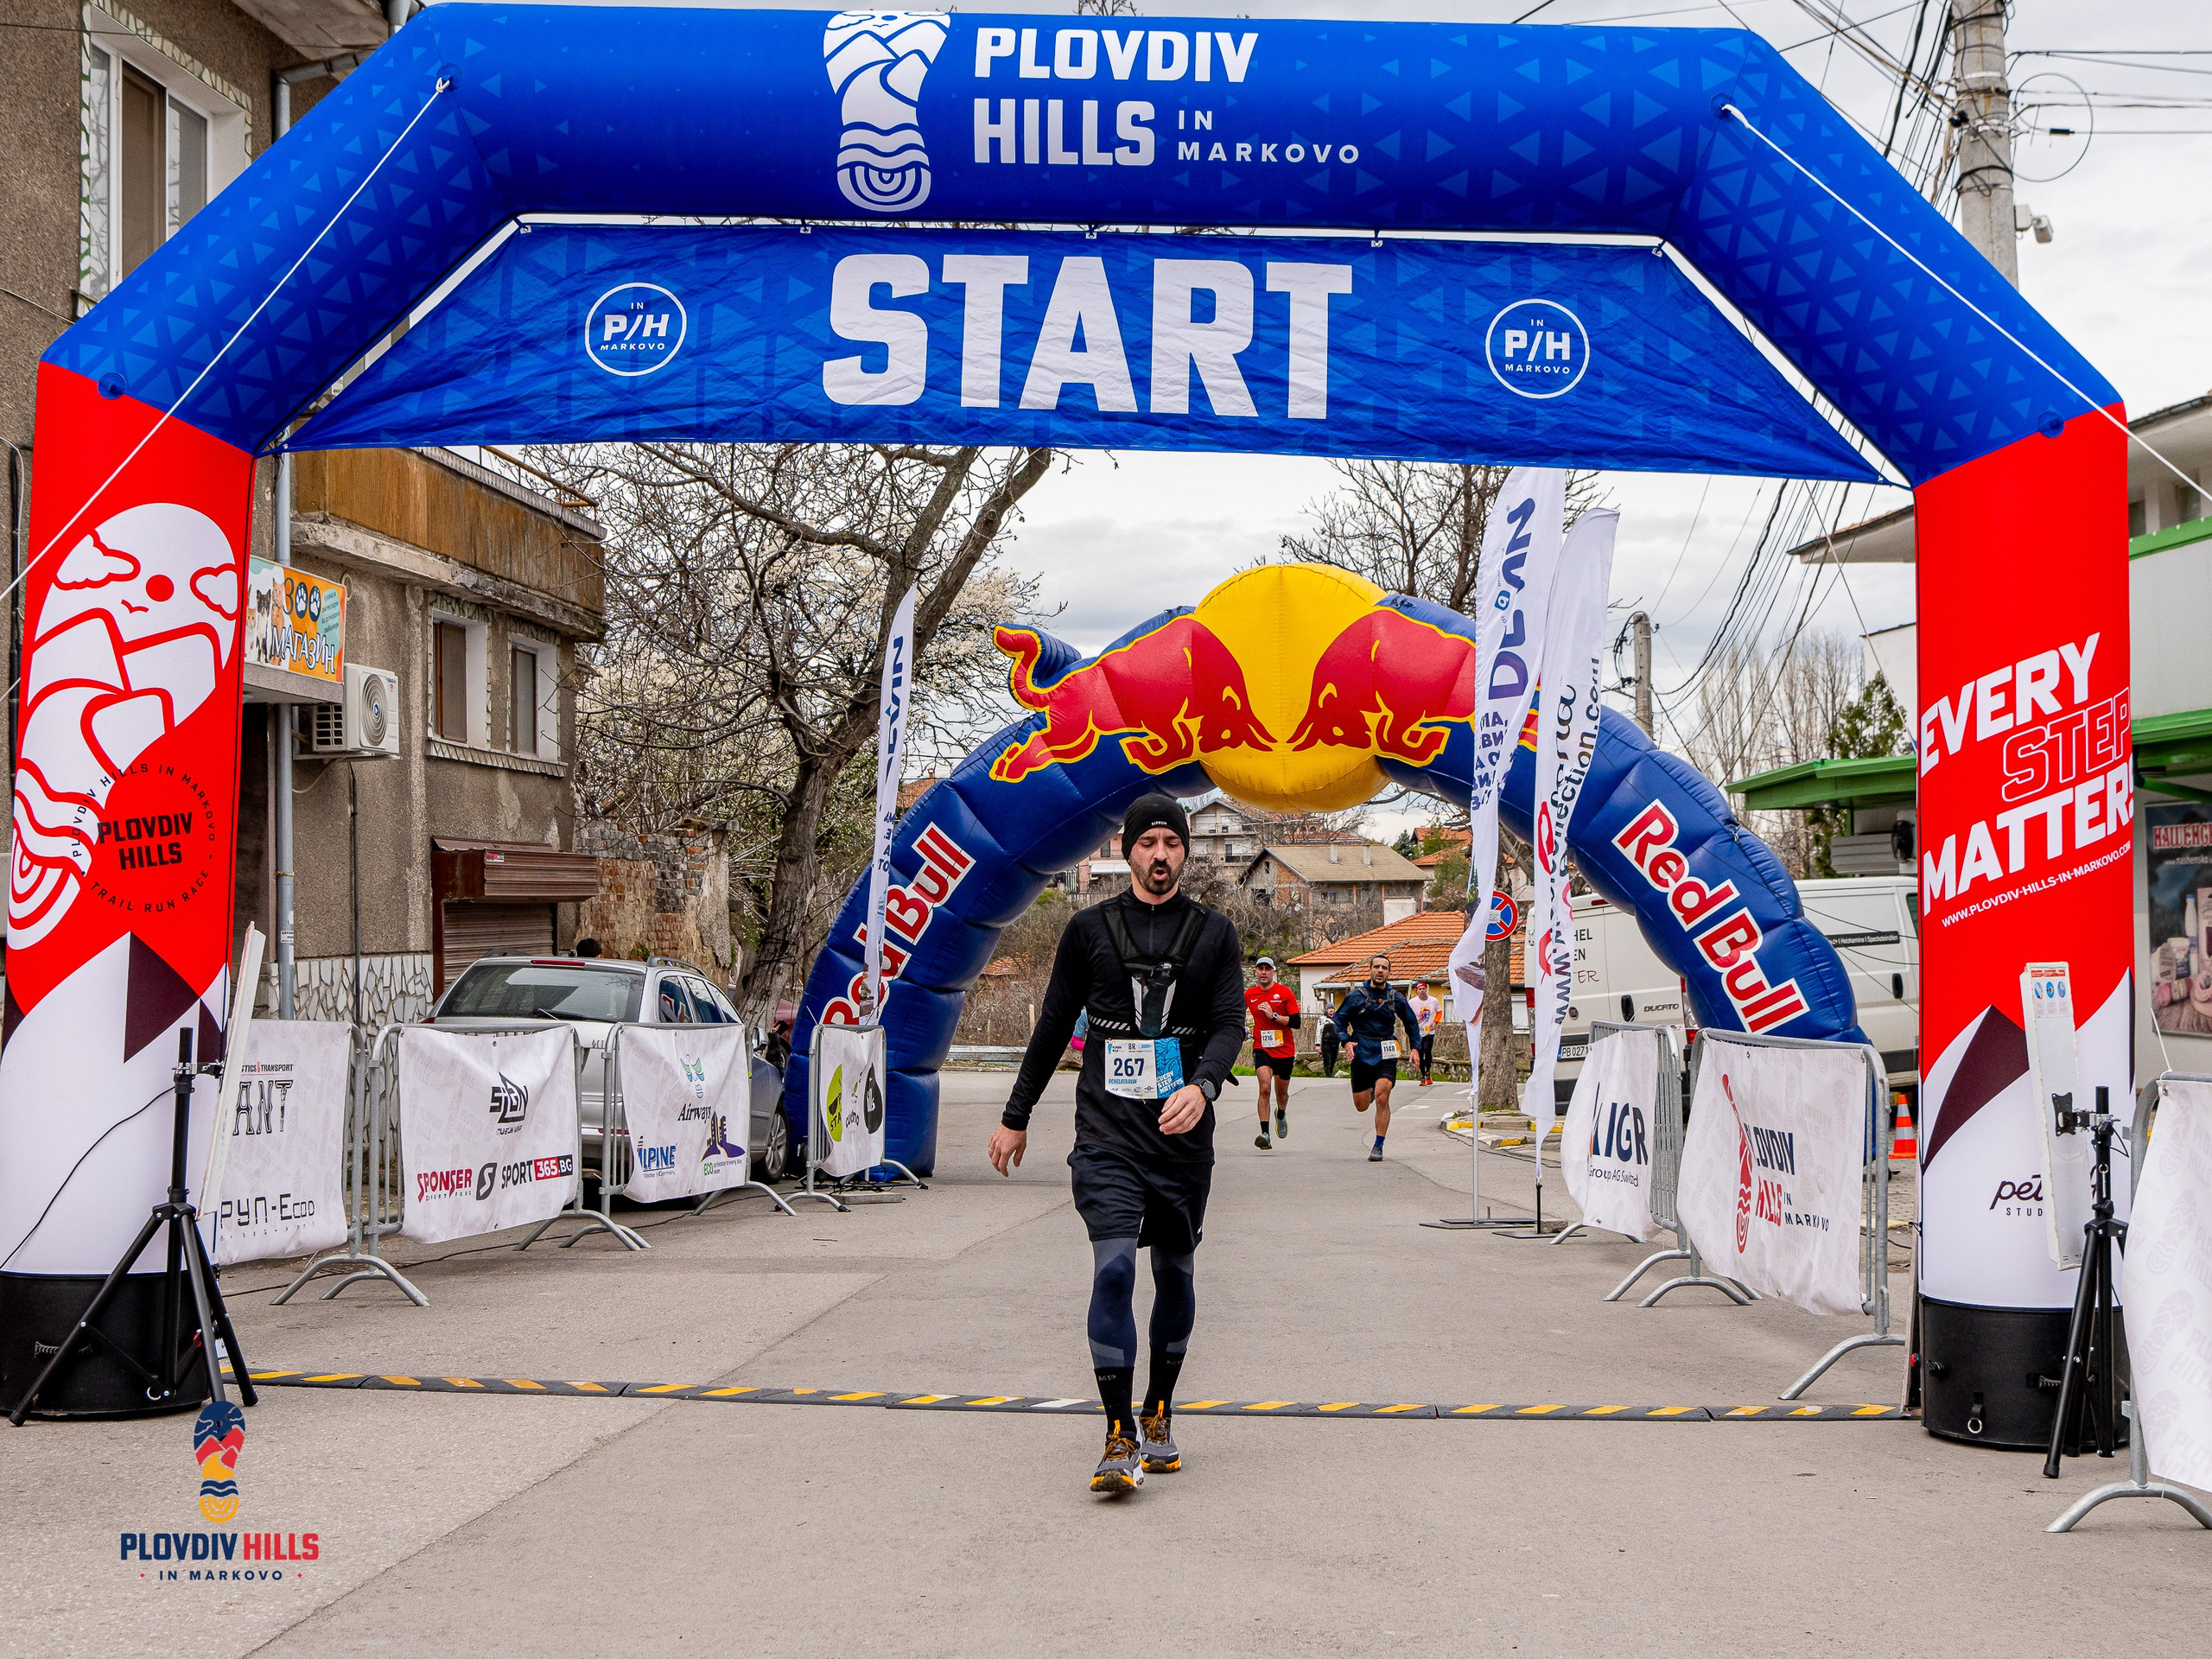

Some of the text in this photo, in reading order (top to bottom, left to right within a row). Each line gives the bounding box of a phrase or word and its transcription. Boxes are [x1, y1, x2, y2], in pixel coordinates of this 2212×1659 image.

[974, 27, 1259, 83] PLOVDIV
[973, 98, 1155, 166] HILLS
[1178, 110, 1213, 131] IN
[1178, 141, 1360, 165] MARKOVO
[631, 302, 644, 310] IN
[603, 314, 670, 341] P/H
[822, 253, 1353, 419] START
[1504, 329, 1571, 362] P/H
[1505, 364, 1571, 374] MARKOVO
[1920, 632, 2101, 779] EVERY
[2001, 686, 2131, 803] STEP
[99, 763, 149, 787] HILLS
[158, 764, 175, 776] IN
[181, 773, 215, 841] MARKOVO
[71, 788, 97, 858] PLOVDIV
[97, 811, 193, 844] PLOVDIV
[1923, 752, 2134, 917] MATTER
[118, 842, 182, 870] HILLS
[1616, 803, 1739, 928] Red
[90, 880, 133, 911] TRAIL
[181, 868, 209, 902] RACE
[886, 826, 971, 941] Bull
[1942, 840, 2132, 928] WWW.PLOVDIV-HILLS-IN-MARKOVO.COM
[143, 899, 175, 913] RUN
[1696, 911, 1808, 1034] Bull
[1643, 1003, 1680, 1012] DUCATO
[261, 1064, 294, 1072] TRANSPORT
[1113, 1058, 1145, 1077] 267
[677, 1103, 711, 1124] Airways
[703, 1161, 714, 1176] ECO
[416, 1168, 473, 1203] SPONSER
[1783, 1192, 1793, 1206] IN
[2005, 1207, 2043, 1217] STUD
